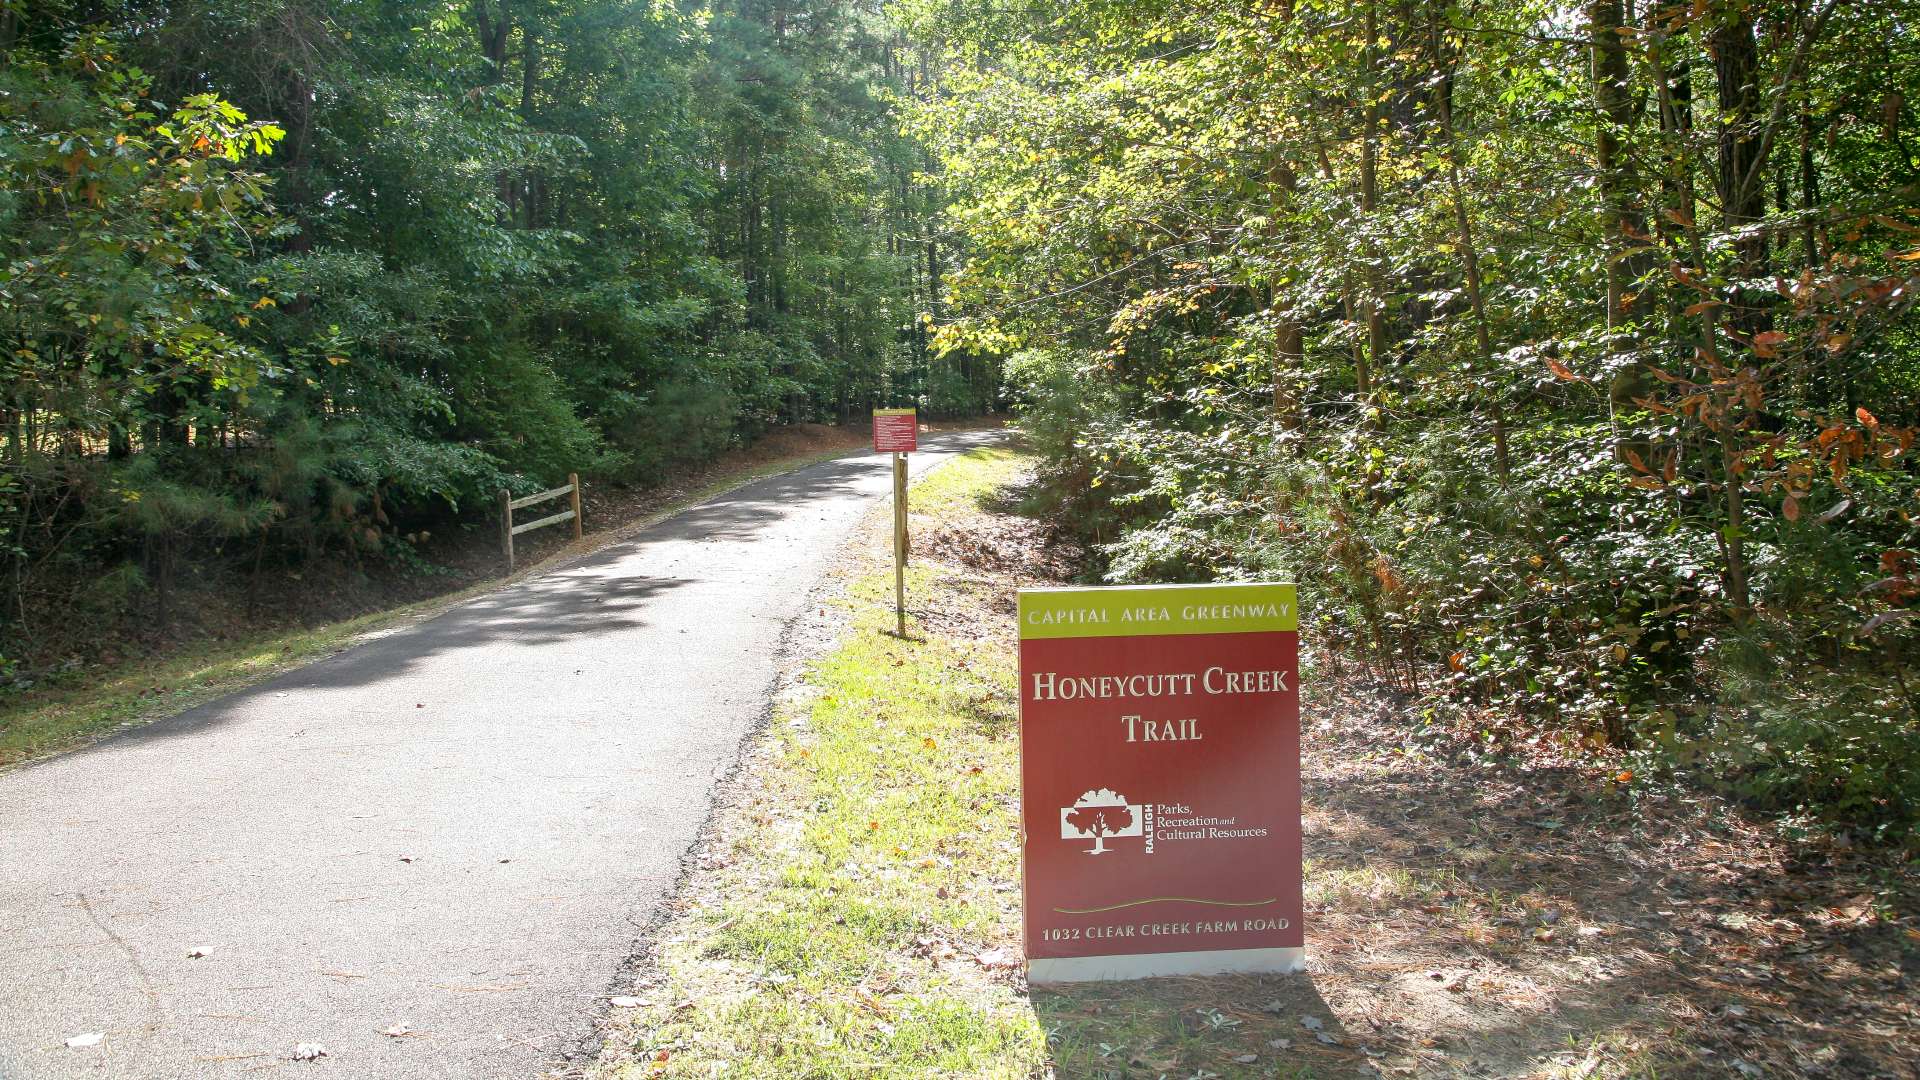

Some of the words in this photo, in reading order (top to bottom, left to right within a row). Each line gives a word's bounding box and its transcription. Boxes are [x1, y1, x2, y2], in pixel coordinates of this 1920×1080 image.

[1027, 607, 1109, 625] CAPITAL
[1121, 607, 1171, 622] AREA
[1182, 603, 1290, 621] GREENWAY
[1032, 672, 1196, 700] HONEYCUTT
[1202, 666, 1289, 695] CREEK
[1121, 715, 1202, 742] TRAIL
[1157, 803, 1193, 815] Parks,
[1145, 804, 1154, 854] RALEIGH
[1157, 816, 1218, 828] Recreation
[1219, 817, 1235, 825] and
[1156, 828, 1205, 840] Cultural
[1209, 827, 1268, 839] Resources
[1042, 928, 1080, 941] 1032
[1085, 924, 1135, 939] CLEAR
[1140, 922, 1190, 936] CREEK
[1195, 921, 1238, 934] FARM
[1243, 918, 1290, 931] ROAD
